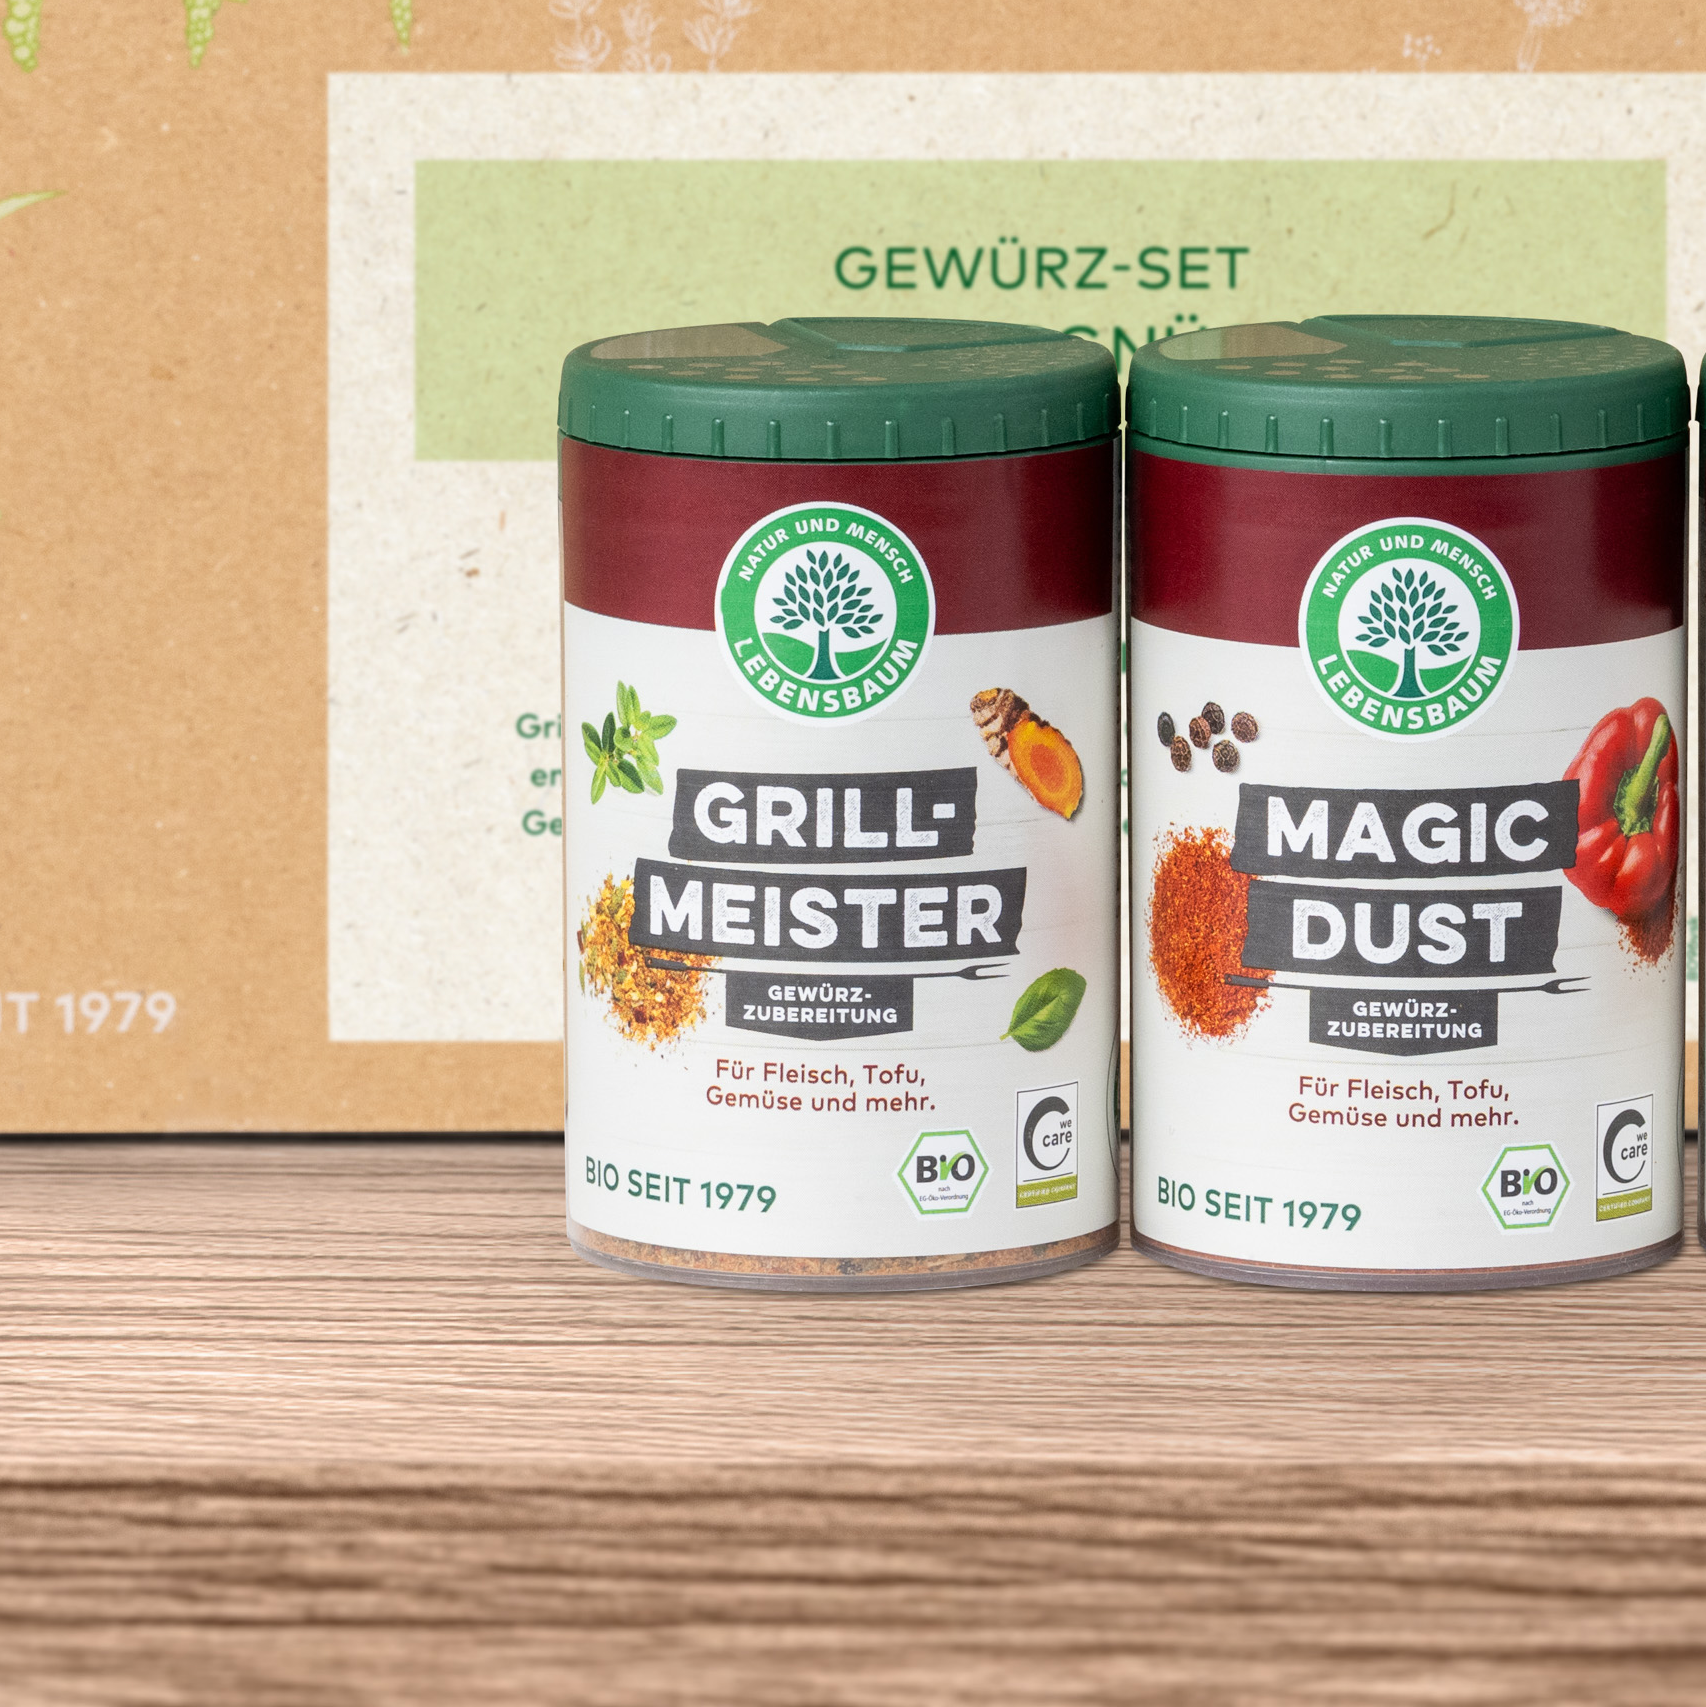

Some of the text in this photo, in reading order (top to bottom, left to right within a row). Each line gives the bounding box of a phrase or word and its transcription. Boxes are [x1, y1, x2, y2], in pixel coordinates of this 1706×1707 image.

[834, 236, 1250, 290] GEWÜRZ-SET
[738, 518, 914, 584] NATUR UND MENSCH
[1322, 535, 1497, 600] NATUR UND MENSCH
[734, 637, 918, 712] LEBENSBAUM
[1318, 654, 1501, 729] LEBENSBAUM
[694, 781, 955, 848] GRILL-
[1267, 796, 1549, 863] MAGIC
[649, 875, 1003, 949] MEISTER
[1293, 899, 1522, 965] DUST
[767, 983, 872, 1003] GEWÜRZ-
[55, 991, 177, 1034] 1979
[743, 1005, 898, 1024] ZUBEREITUNG
[1353, 999, 1457, 1018] GEWÜRZ-
[1327, 1021, 1482, 1038] ZUBEREITUNG
[716, 1058, 925, 1088] Für Fleisch, Tofu,
[706, 1086, 936, 1112] Gemüse und mehr.
[1300, 1075, 1509, 1103] Für Fleisch, Tofu,
[1060, 1119, 1072, 1129] we
[1289, 1103, 1519, 1127] Gemüse und mehr.
[1042, 1129, 1073, 1148] care
[1637, 1131, 1648, 1142] we
[1621, 1143, 1648, 1161] care
[586, 1155, 777, 1213] BIO SEIT 1979
[919, 1194, 969, 1202] EG-Öko-Verordnung
[1157, 1176, 1361, 1231] BIO SEIT 1979
[1504, 1208, 1551, 1216] EG-Öko-Verordnung
